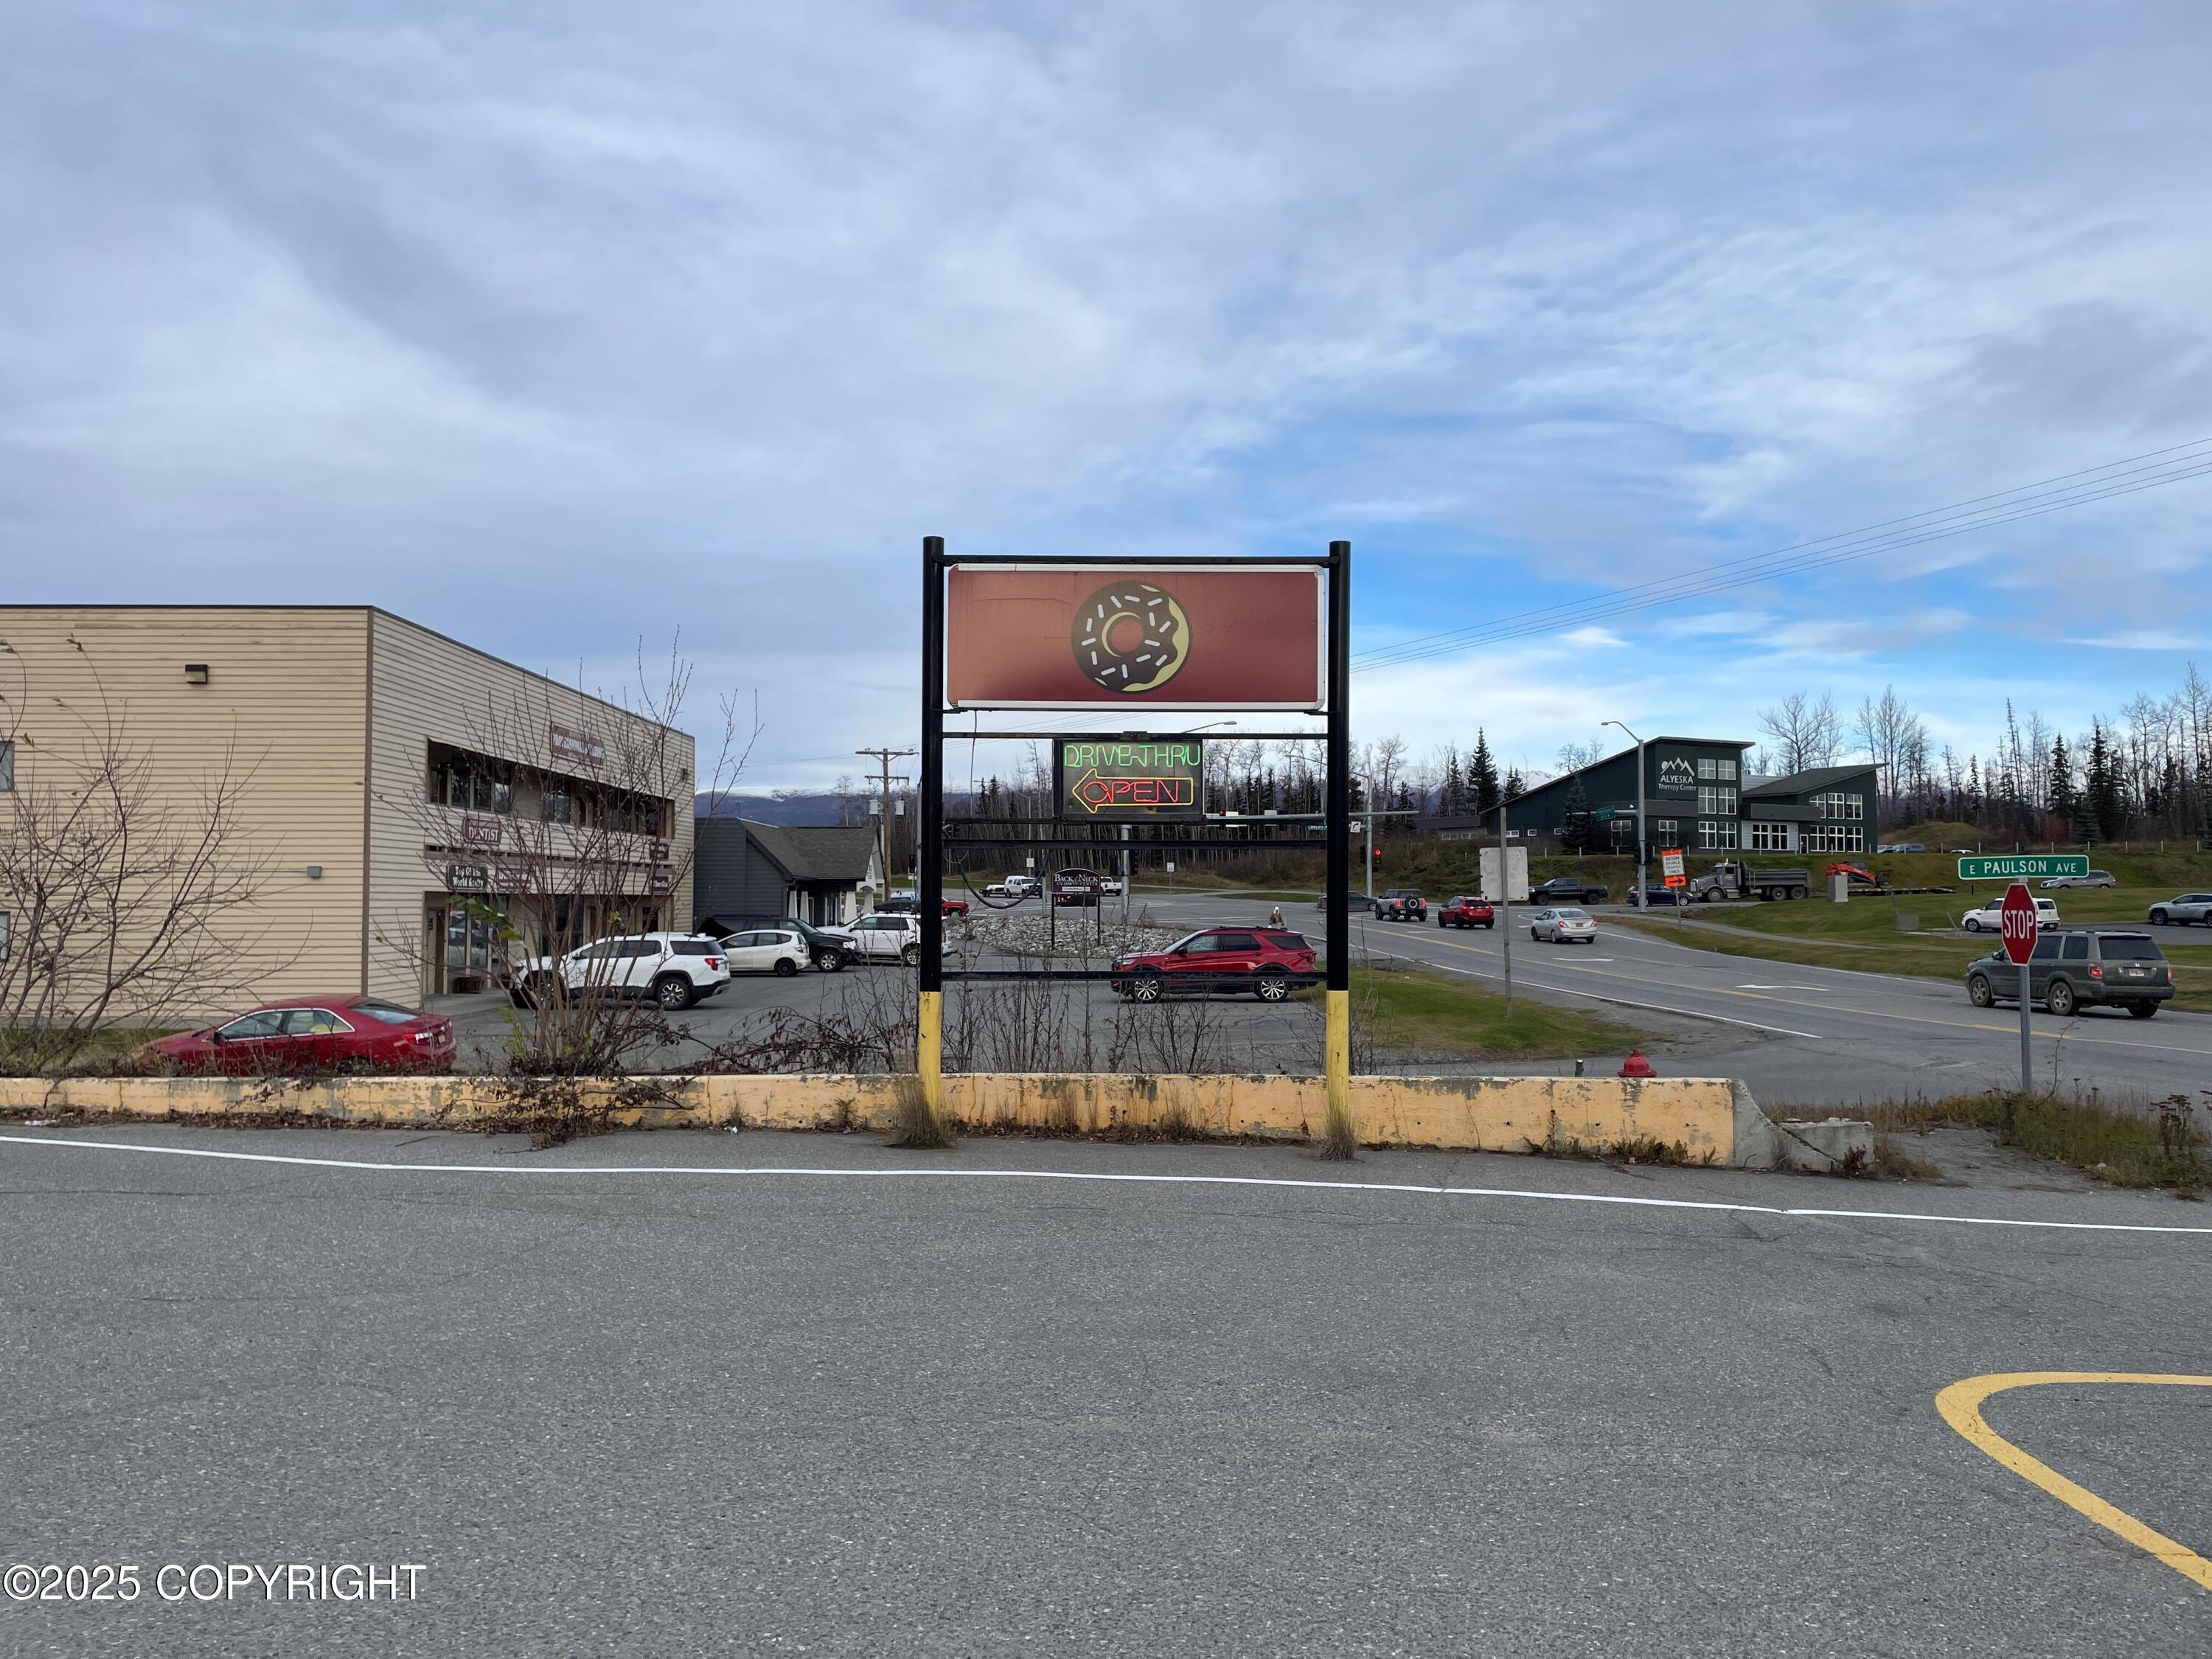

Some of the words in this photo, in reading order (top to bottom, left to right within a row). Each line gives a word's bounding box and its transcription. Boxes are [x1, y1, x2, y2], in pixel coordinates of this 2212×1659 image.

[1660, 775, 1694, 784] ALYESKA
[1083, 780, 1178, 803] OPEN
[1658, 783, 1679, 791] Therapy
[468, 827, 498, 841] DENTIST
[1969, 865, 1975, 874] E
[1984, 860, 2047, 874] PAULSON
[2056, 863, 2076, 872] AVE
[2004, 909, 2034, 939] STOP
